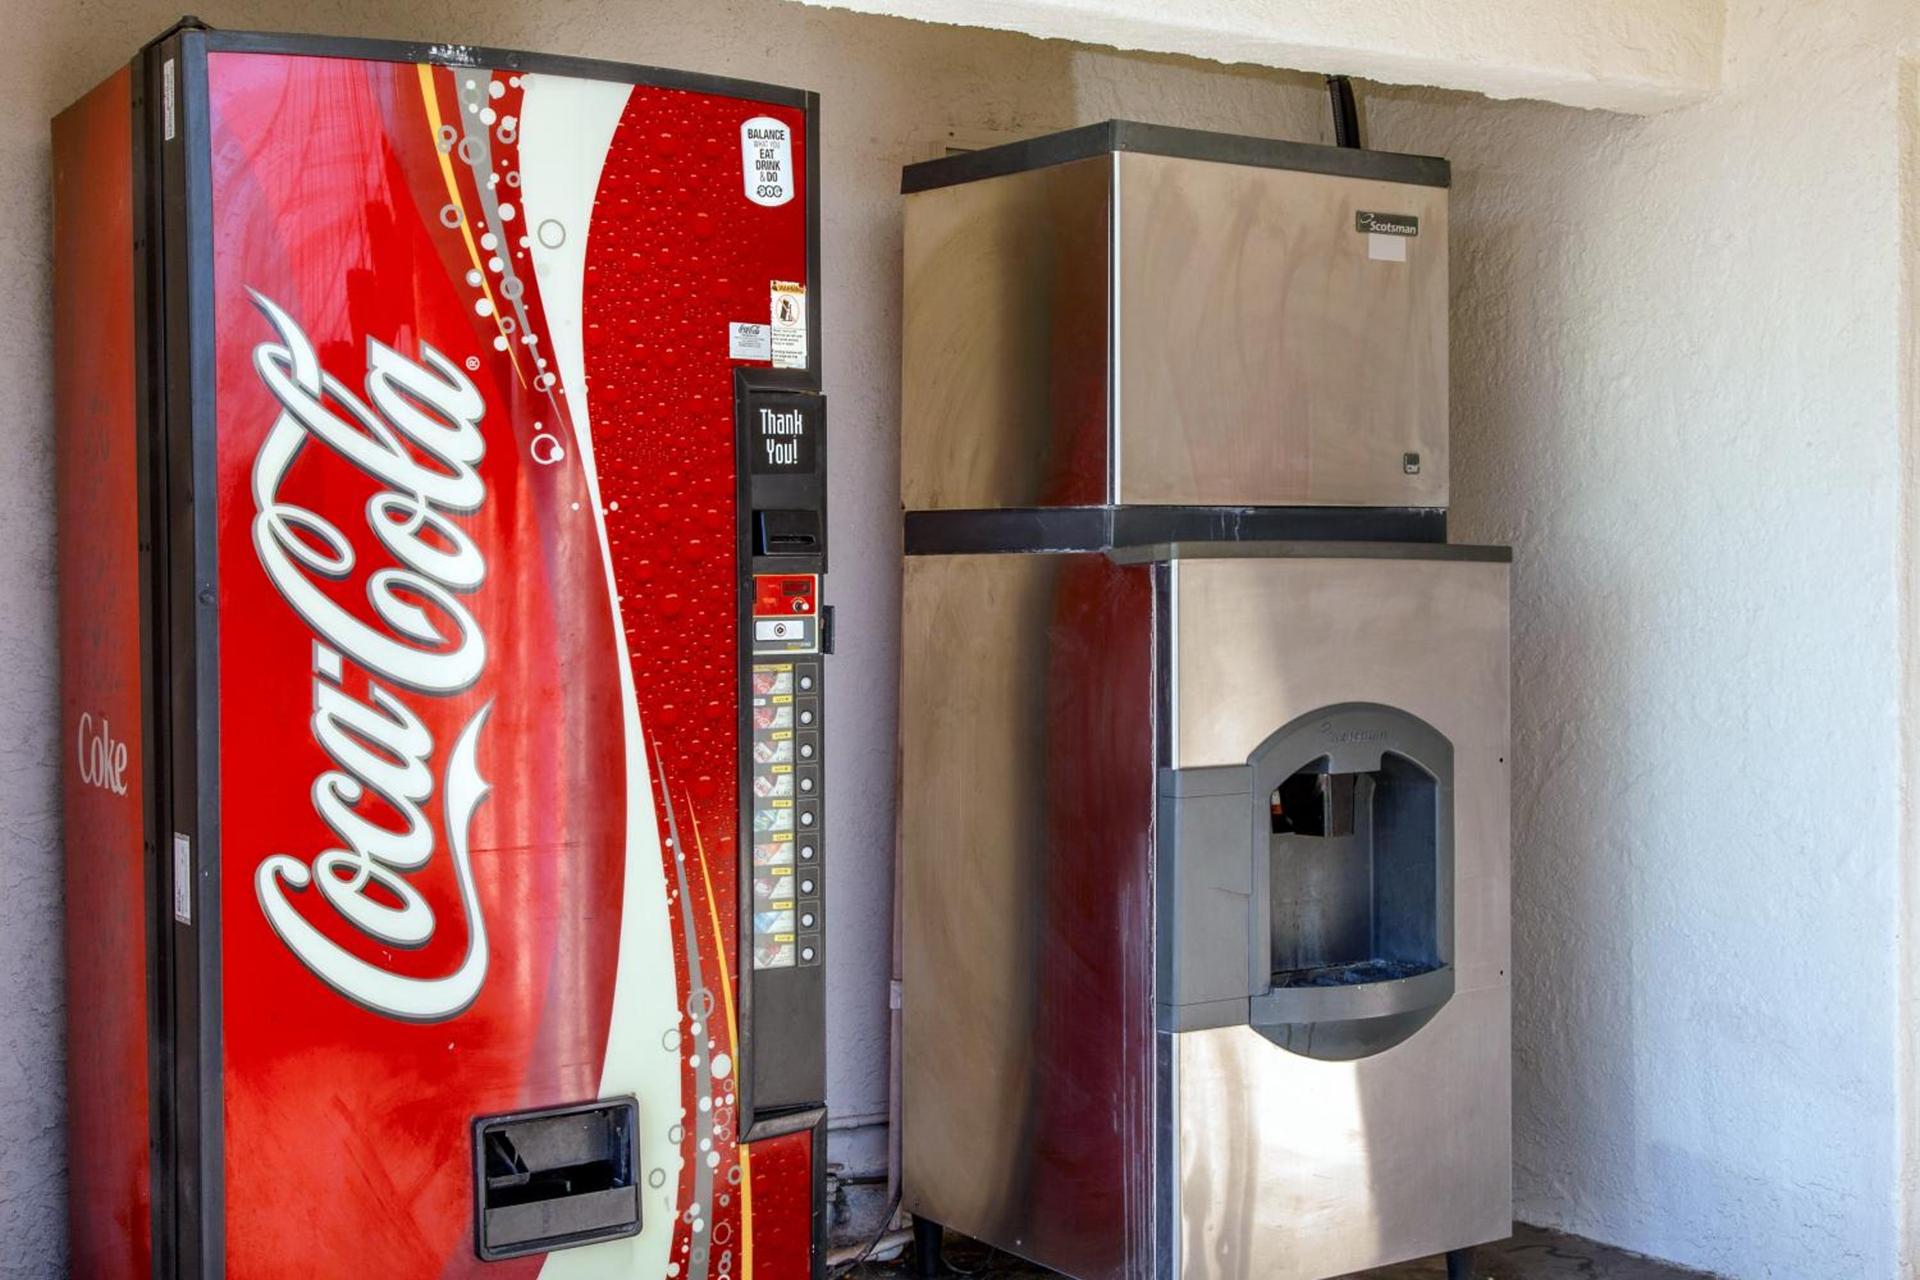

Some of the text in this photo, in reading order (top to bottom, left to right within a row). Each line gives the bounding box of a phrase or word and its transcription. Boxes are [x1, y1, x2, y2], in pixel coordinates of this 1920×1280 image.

[747, 128, 785, 140] BALANCE
[759, 148, 774, 159] EAT
[755, 159, 780, 171] DRINK
[766, 171, 778, 182] DO
[1370, 221, 1417, 234] Scotsman
[759, 408, 803, 435] Thank
[766, 438, 798, 465] You!
[244, 285, 493, 1023] Coca-Cola
[78, 711, 128, 796] Coke
